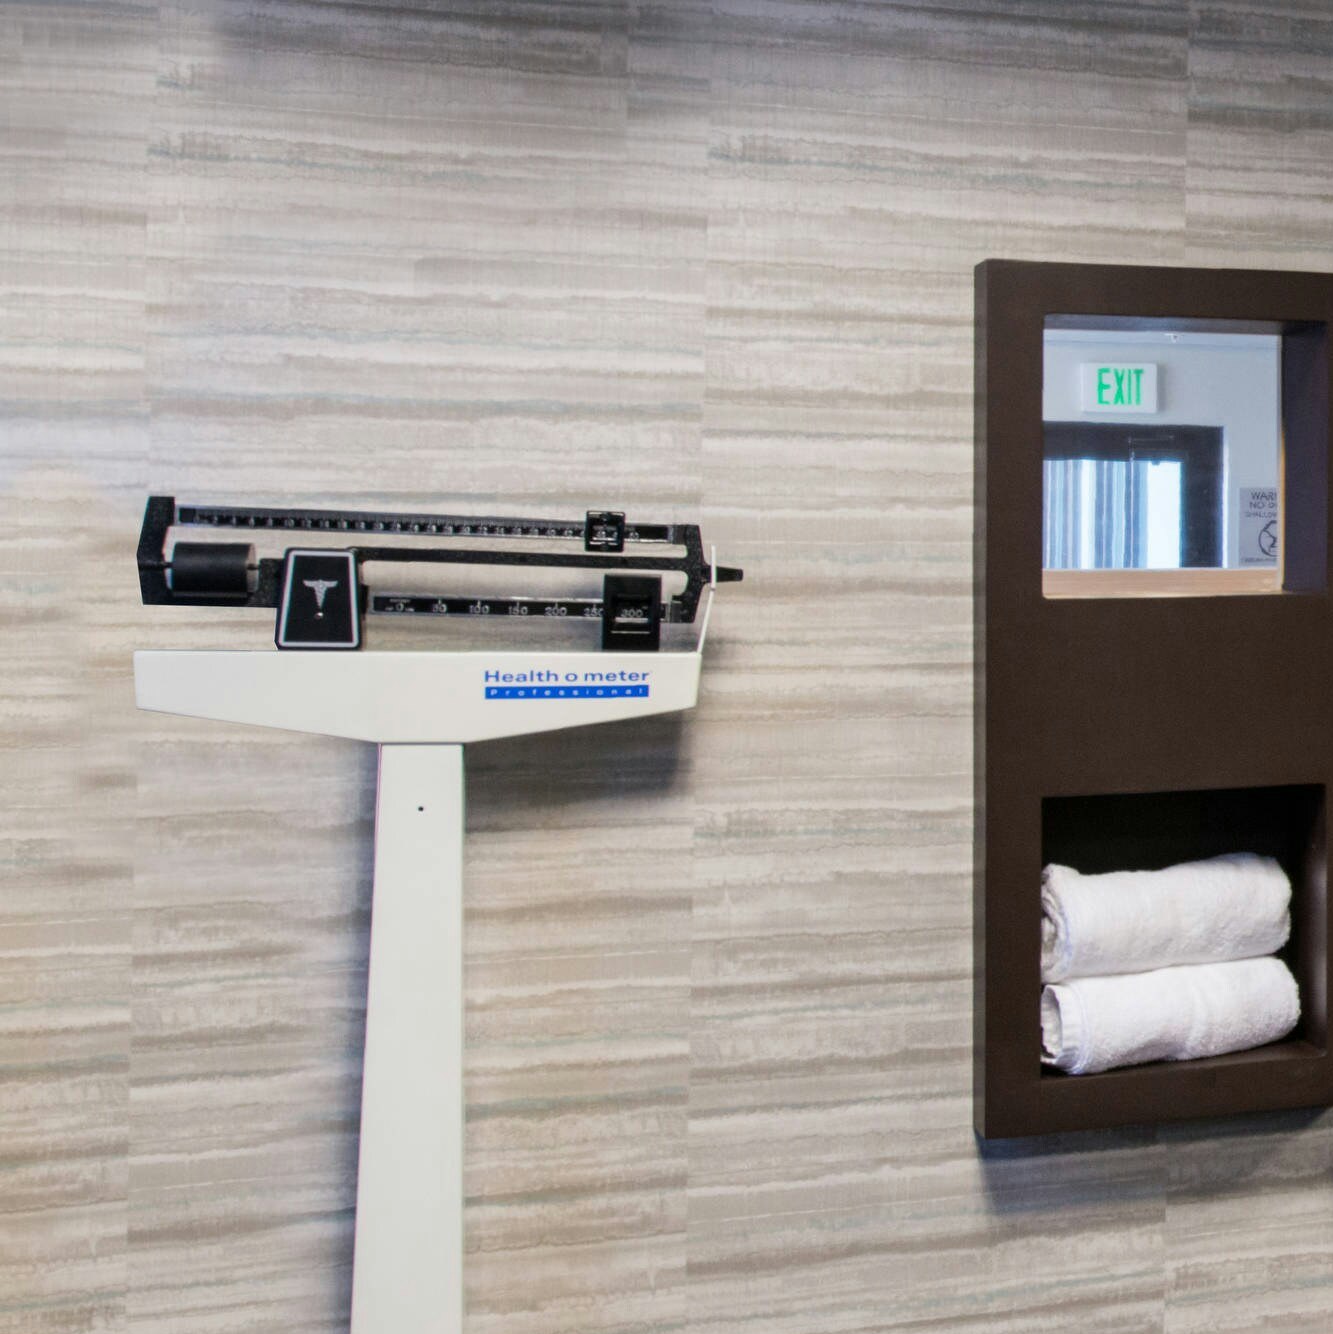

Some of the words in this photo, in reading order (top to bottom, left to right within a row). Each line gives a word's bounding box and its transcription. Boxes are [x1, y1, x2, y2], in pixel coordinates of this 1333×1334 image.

[1097, 368, 1144, 405] EXIT
[469, 604, 489, 615] 100
[508, 605, 528, 616] 150
[484, 670, 559, 683] Health
[565, 672, 578, 682] o
[584, 670, 649, 682] meter
[490, 687, 643, 697] Professional
